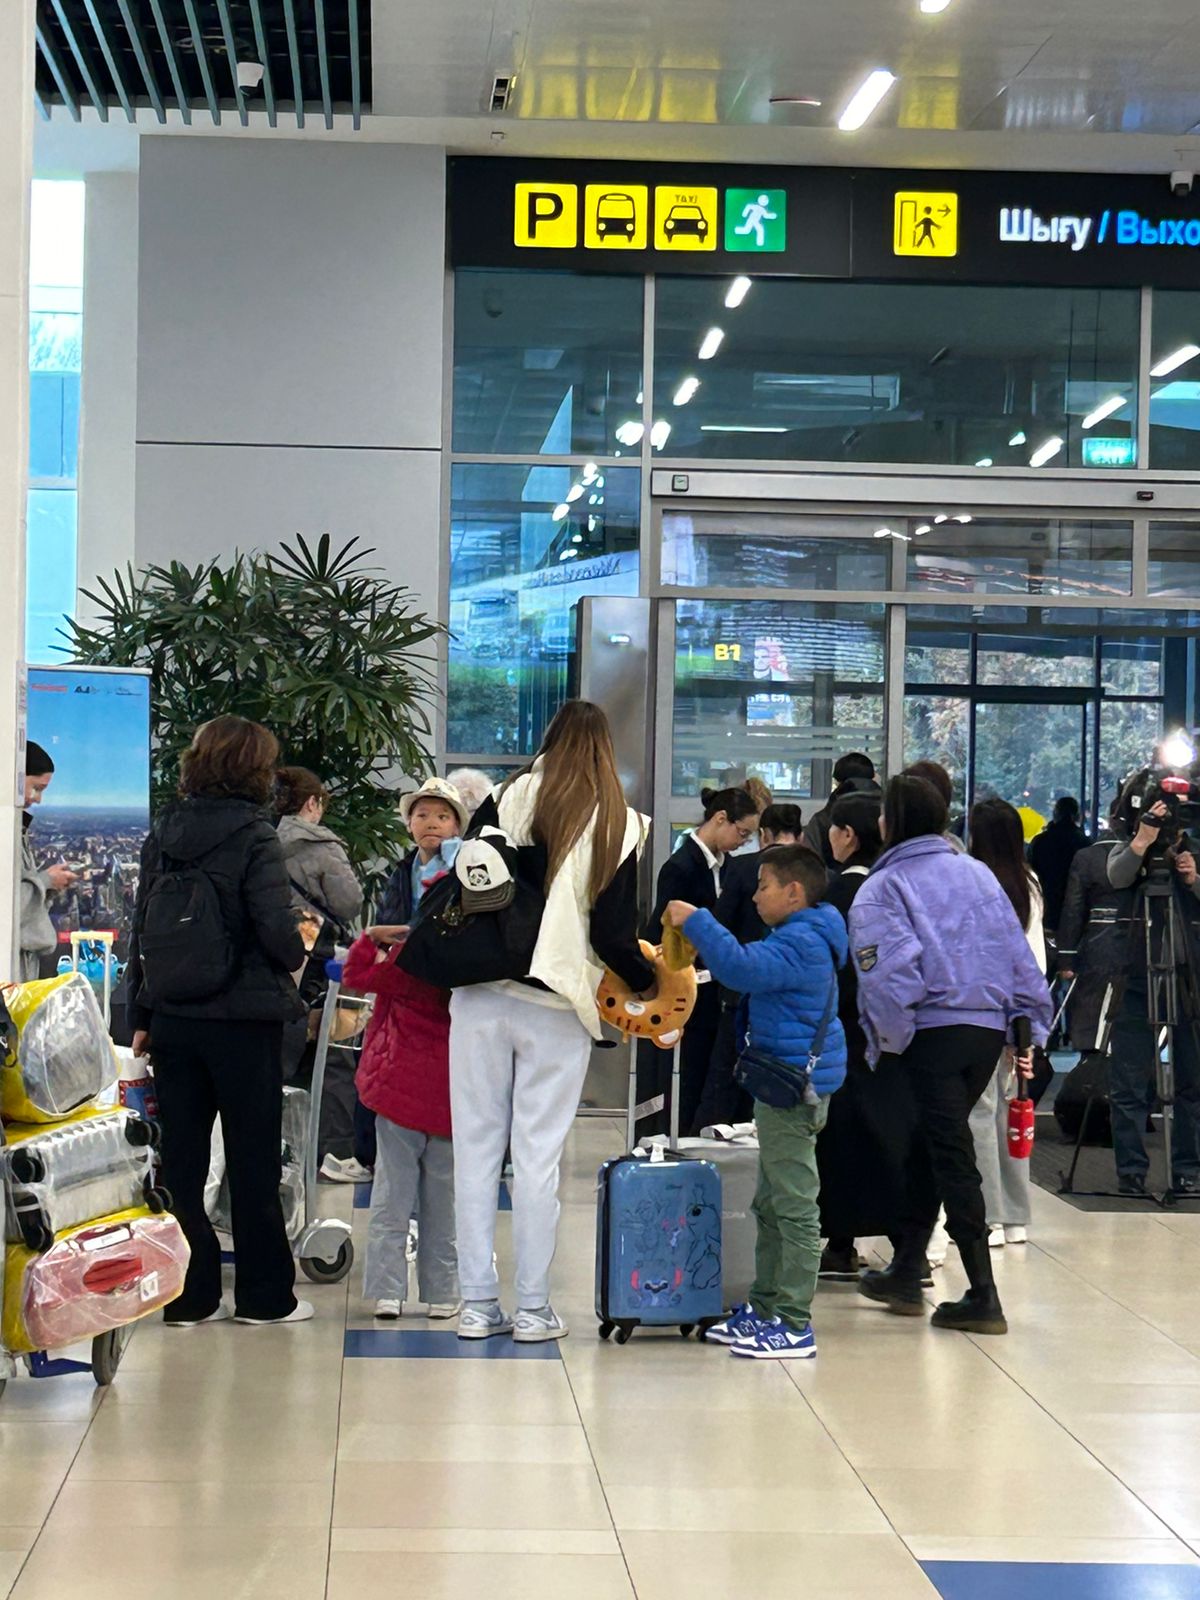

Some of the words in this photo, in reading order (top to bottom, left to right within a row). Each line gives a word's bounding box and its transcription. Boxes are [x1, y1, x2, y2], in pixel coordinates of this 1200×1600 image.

[674, 194, 698, 204] TAXI
[528, 192, 564, 239] P
[999, 207, 1092, 251] Шығу
[1097, 209, 1110, 243] /
[715, 643, 741, 662] B1
